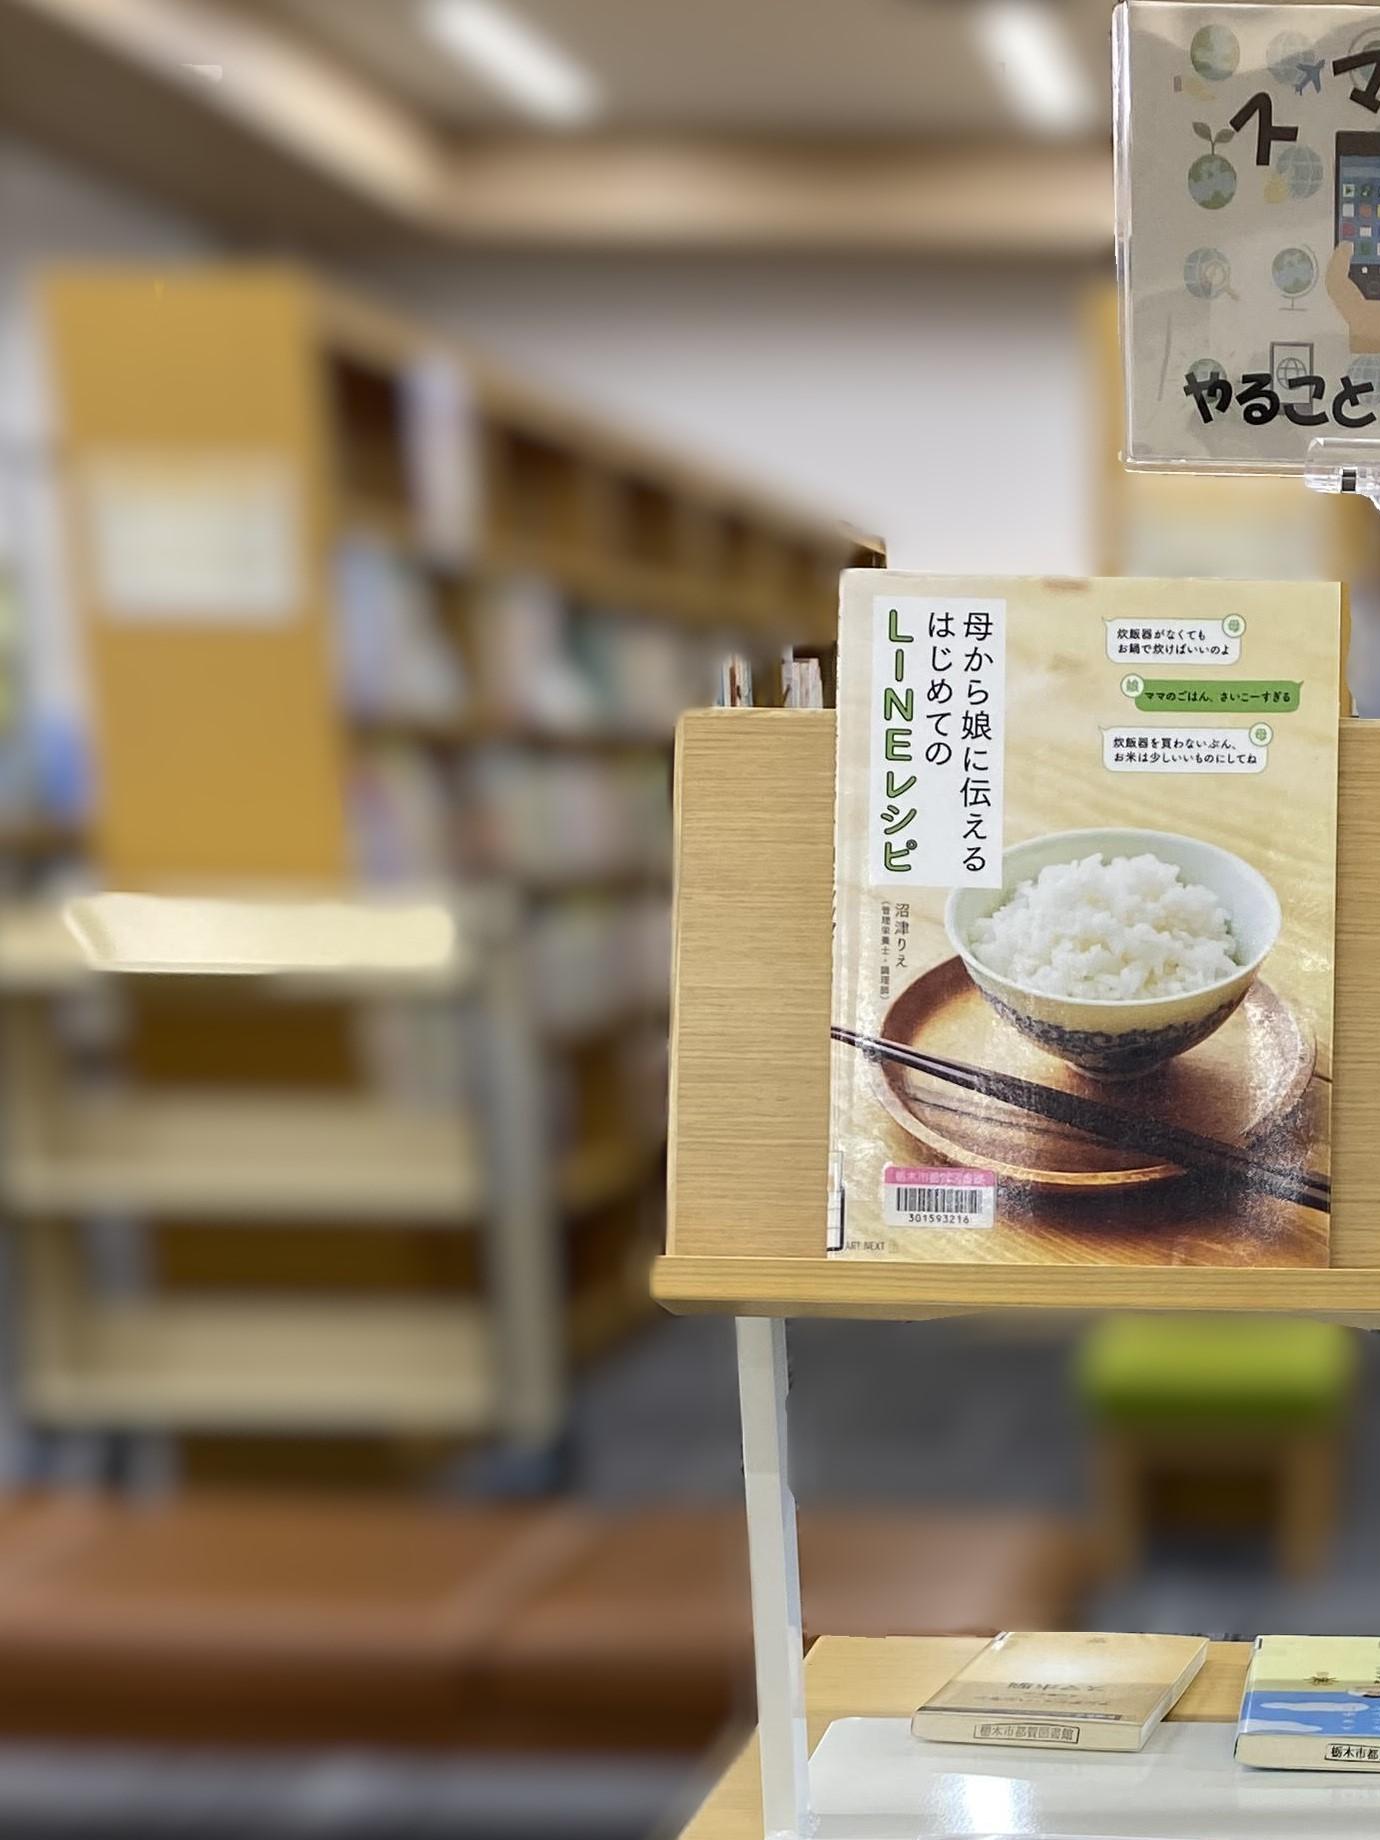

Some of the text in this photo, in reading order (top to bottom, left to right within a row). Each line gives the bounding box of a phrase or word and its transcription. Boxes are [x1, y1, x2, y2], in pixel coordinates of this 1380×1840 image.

[1116, 628, 1206, 641] 炊飯器がなくても
[1117, 643, 1230, 655] お鍋で炊けばいいのよ
[925, 612, 955, 765] はじめての
[1144, 690, 1291, 703] ママのごはん、さいこーすぎる
[880, 609, 918, 873] LINEレシピ
[961, 610, 994, 873] 母から娘に伝える
[1113, 737, 1237, 750] 炊飯器を買わないぶん、
[1114, 752, 1257, 764] お米は少しいいものにしてね
[895, 903, 910, 968] 沼津りえ
